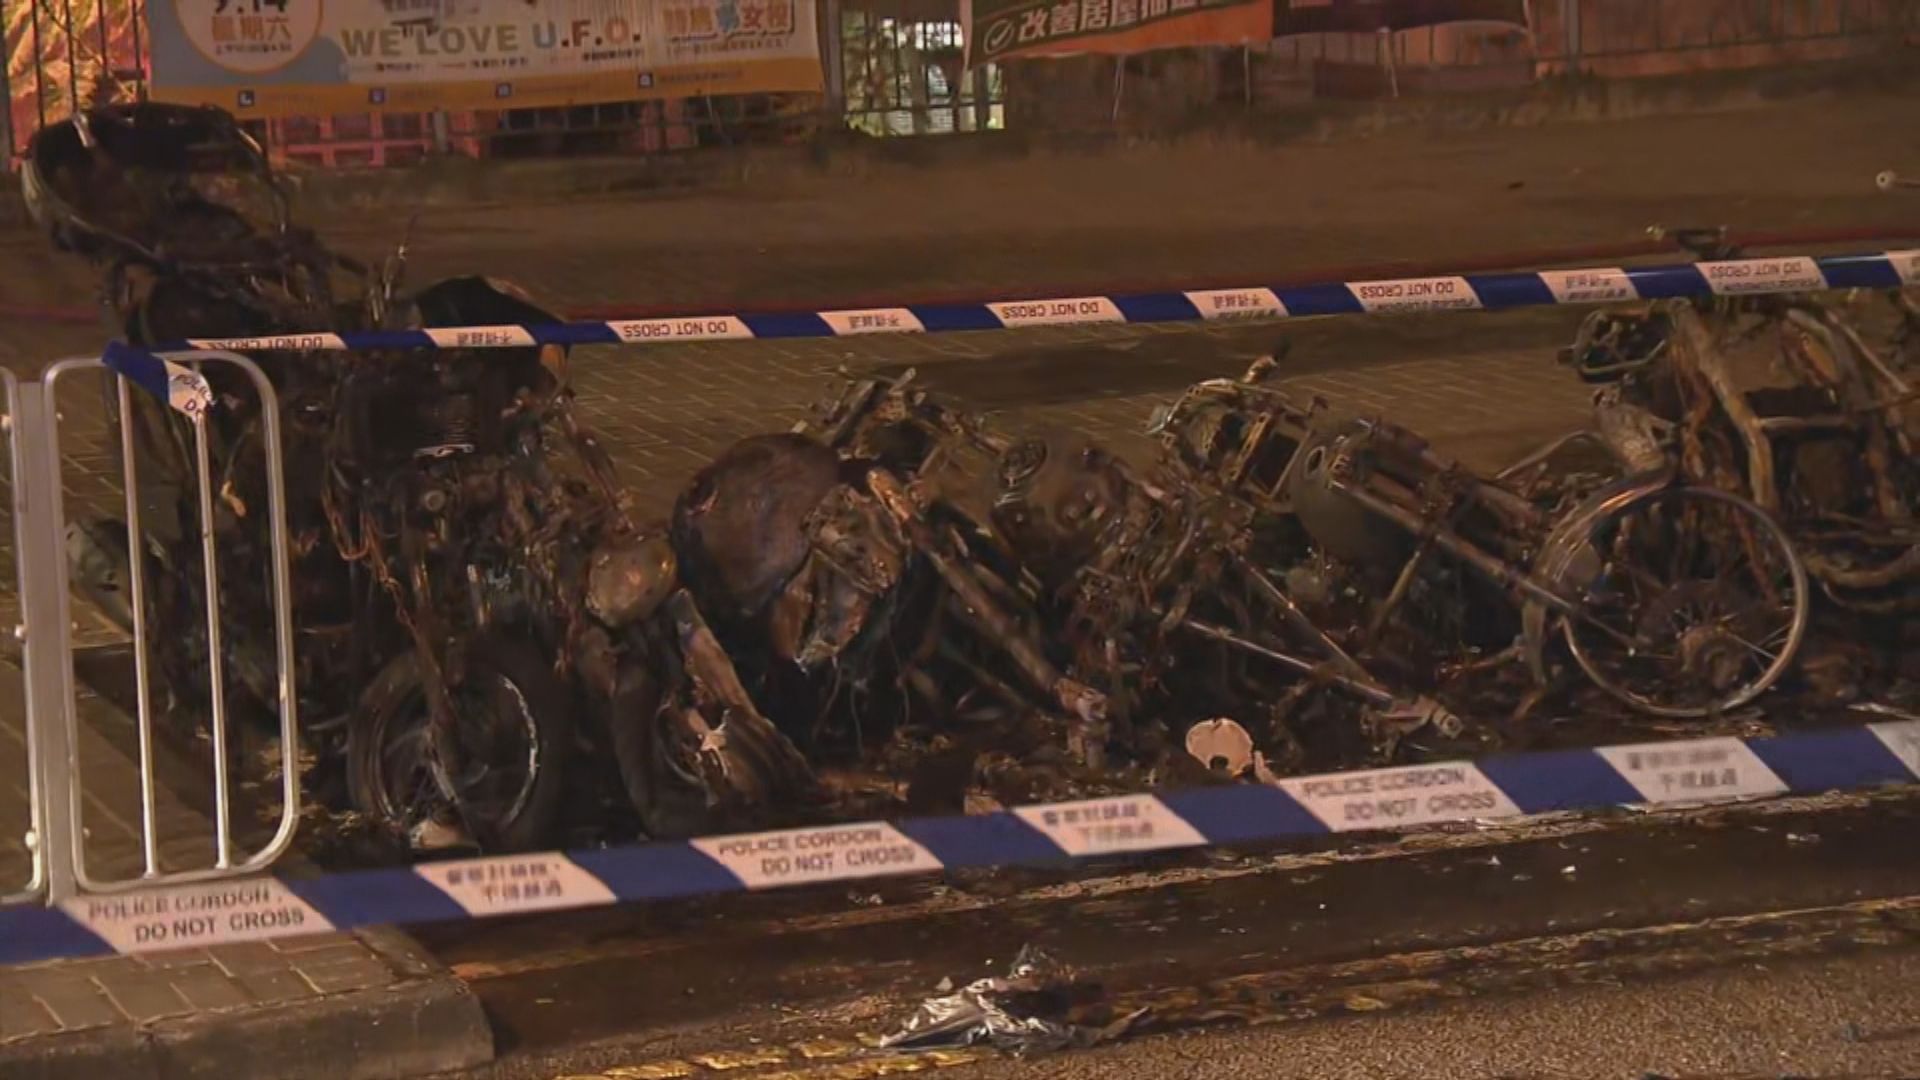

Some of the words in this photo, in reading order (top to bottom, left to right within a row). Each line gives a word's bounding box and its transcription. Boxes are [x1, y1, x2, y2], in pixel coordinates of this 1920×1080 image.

[341, 27, 400, 58] WE
[416, 24, 519, 56] LOVE
[532, 19, 641, 49] U.F.O.
[1359, 285, 1401, 299] CROSS
[1406, 283, 1432, 296] NOT
[1435, 281, 1454, 293] DO
[1002, 305, 1046, 320] CROSS
[1049, 303, 1077, 316] NOT
[1079, 301, 1099, 314] DO
[623, 324, 671, 338] CROSS
[675, 322, 703, 335] NOT
[707, 321, 727, 333] DO
[1343, 801, 1374, 821] DO
[1377, 798, 1417, 817] NOT
[1427, 790, 1497, 814] CROSS
[719, 837, 790, 857] POLICE
[794, 827, 882, 849] CORDON
[761, 858, 791, 876] DO
[796, 852, 834, 872] NOT
[845, 845, 916, 867] CROSS
[88, 893, 169, 920] POLICE
[135, 924, 168, 943] DO
[172, 916, 217, 938] NOT
[229, 906, 305, 933] CROSS
